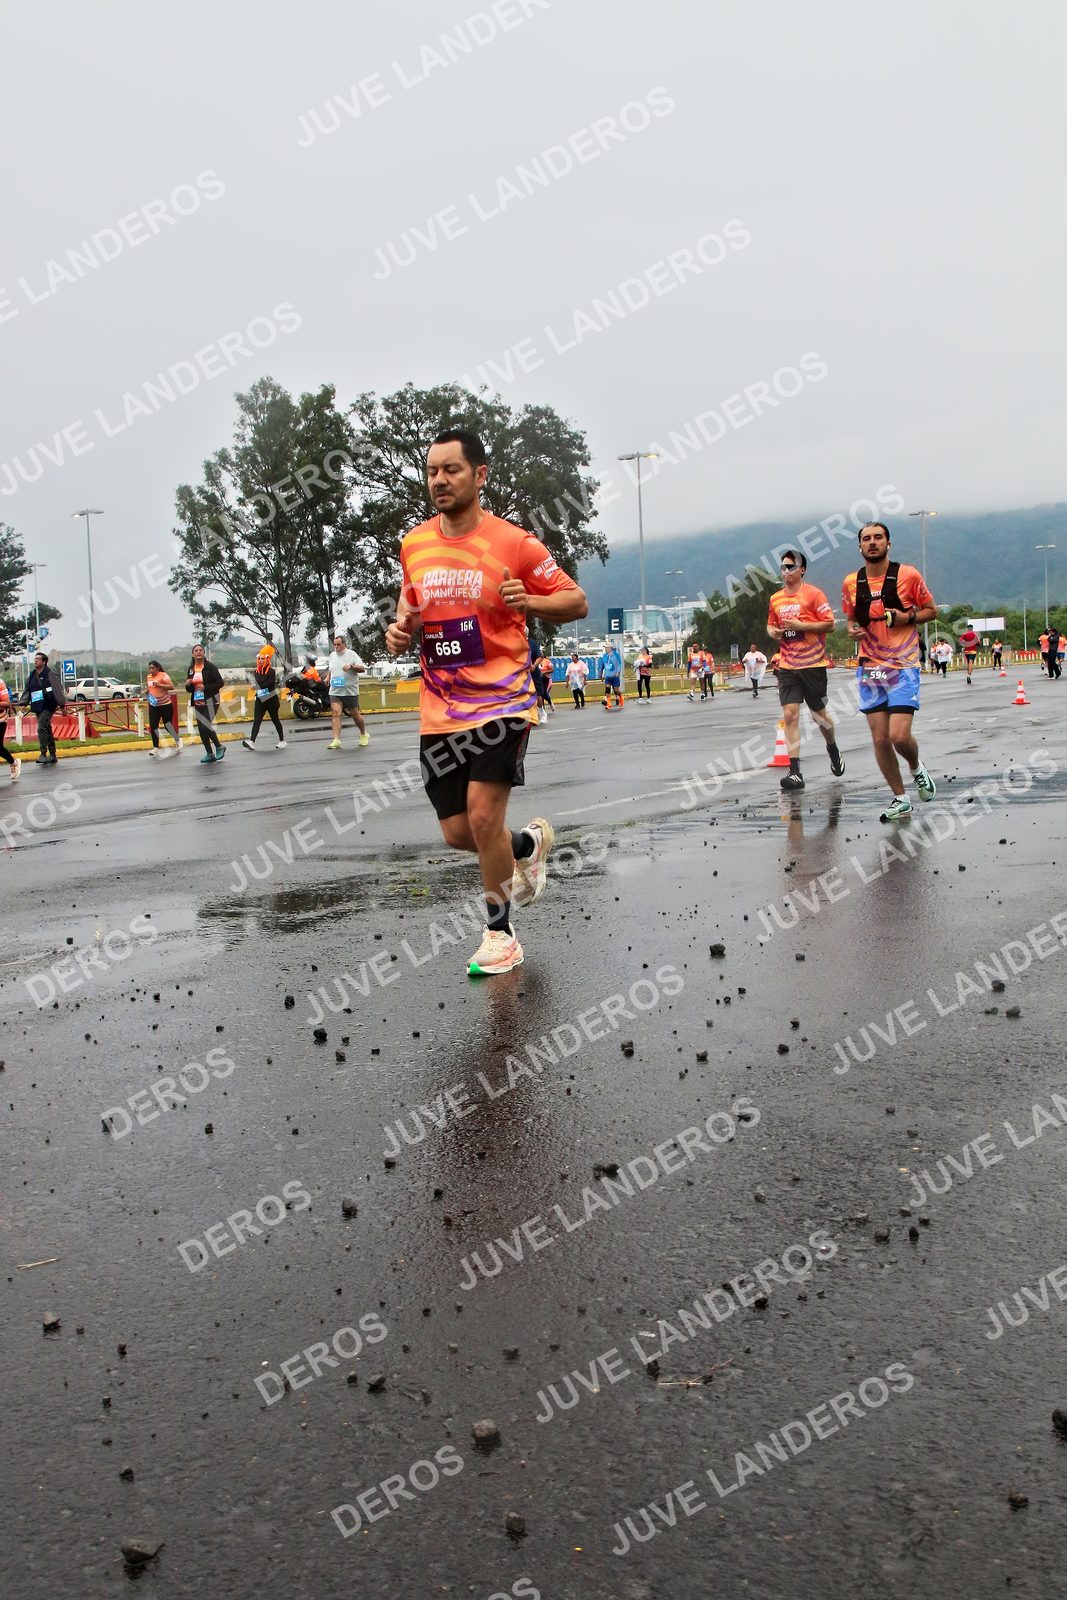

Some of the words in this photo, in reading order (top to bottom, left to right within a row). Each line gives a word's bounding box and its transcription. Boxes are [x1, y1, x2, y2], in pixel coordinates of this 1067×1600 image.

[422, 568, 484, 587] CARRERA
[422, 587, 469, 600] OMNILIFE
[610, 618, 620, 630] E
[435, 640, 462, 656] 668
[870, 670, 888, 680] 594
